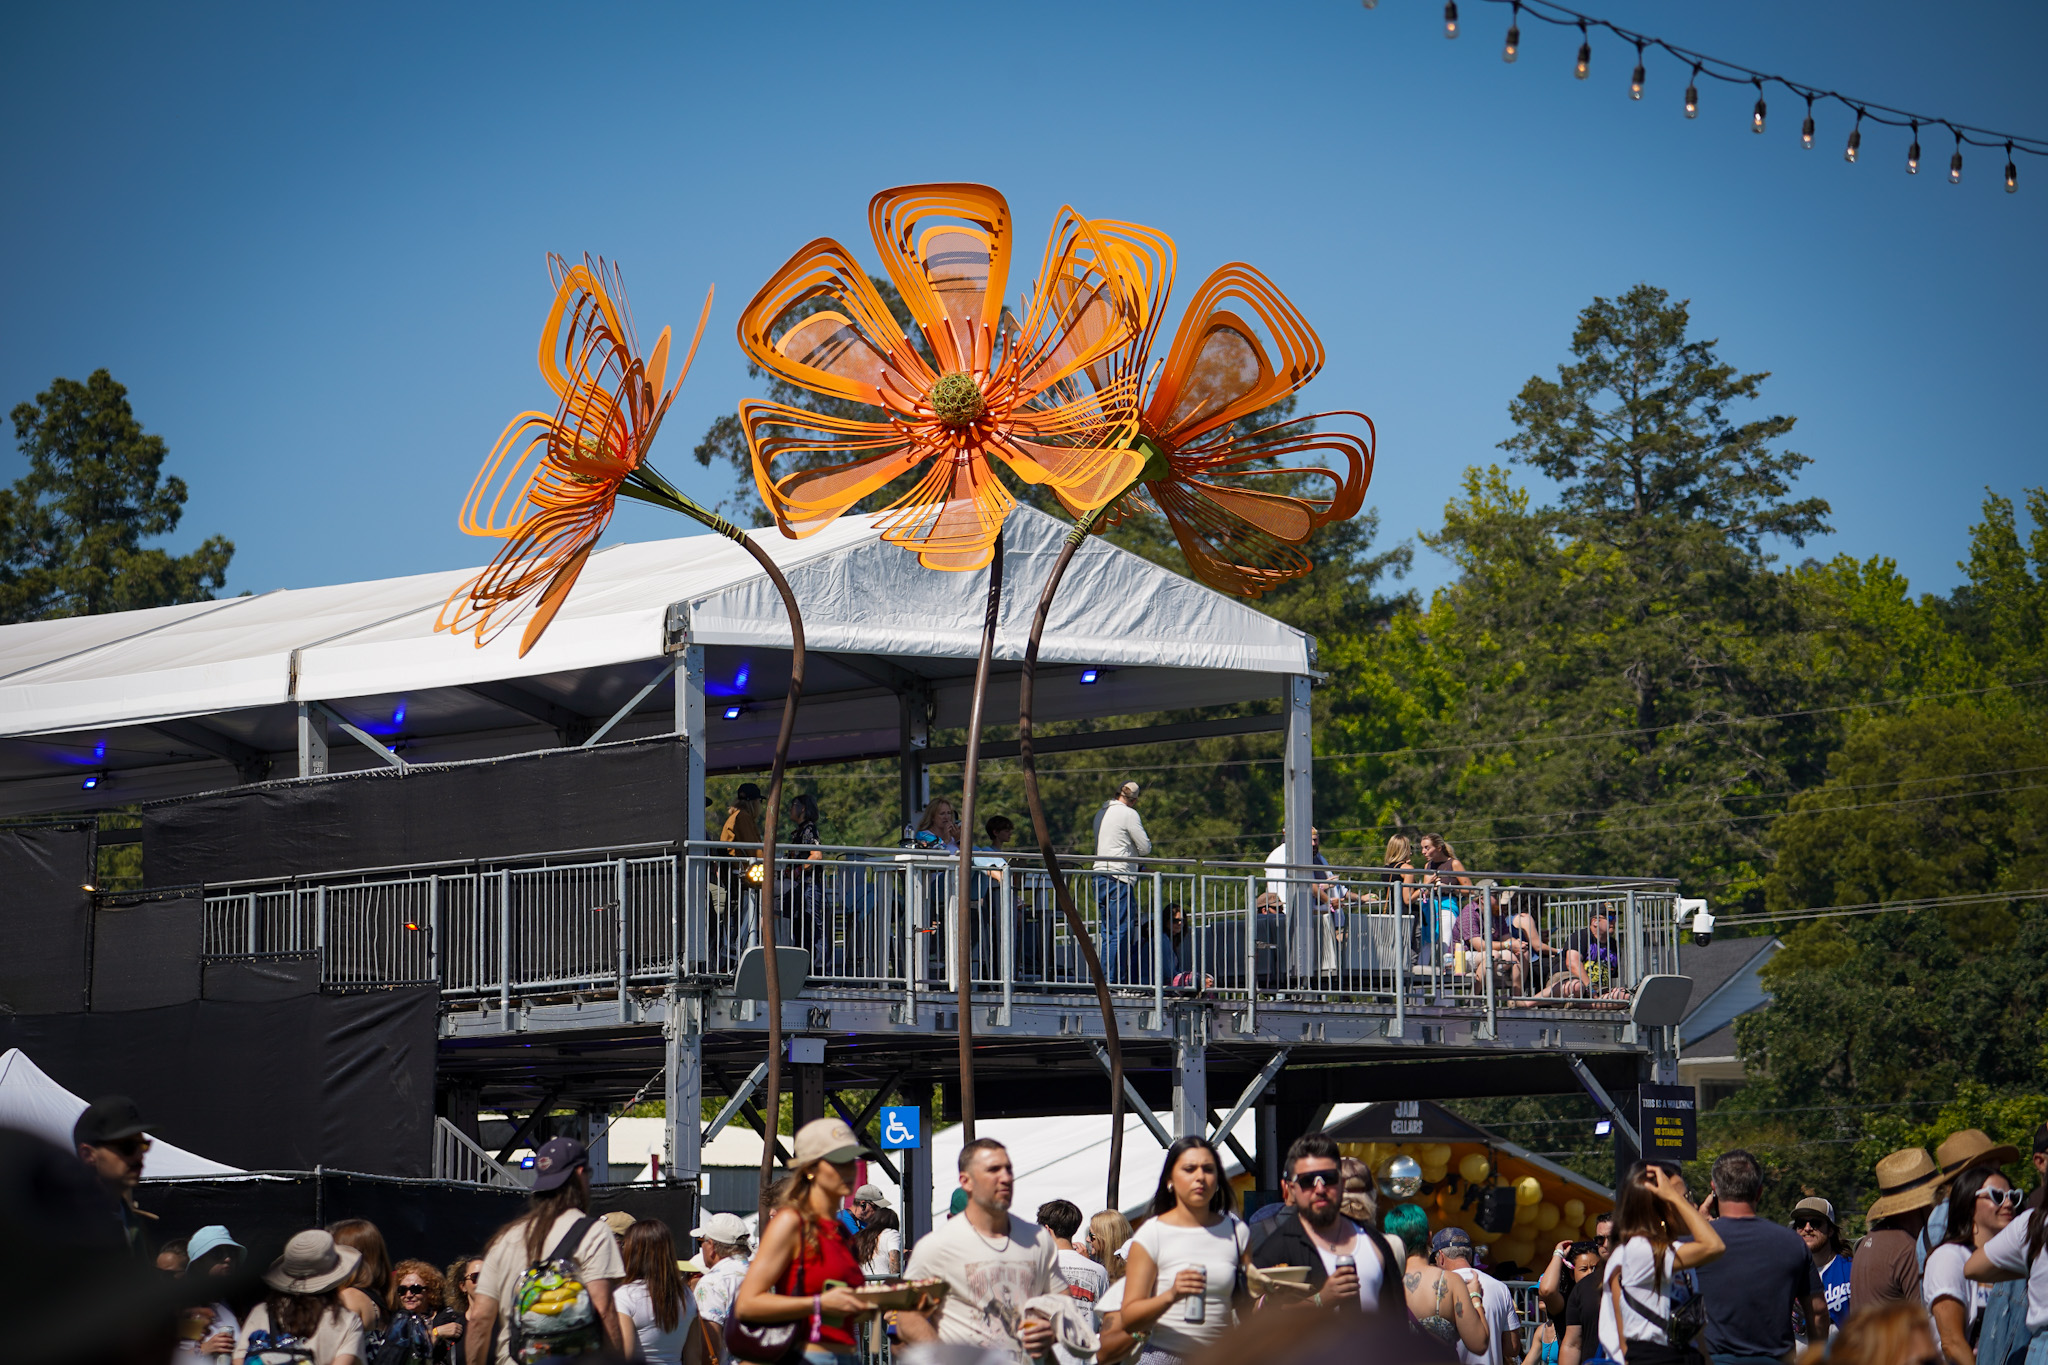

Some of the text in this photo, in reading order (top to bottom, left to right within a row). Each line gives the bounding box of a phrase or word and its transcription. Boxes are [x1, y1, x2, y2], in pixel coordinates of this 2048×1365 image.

[1642, 1098, 1655, 1108] THIS
[1656, 1099, 1662, 1108] IS
[1663, 1100, 1667, 1108] A
[1395, 1101, 1419, 1118] JAM
[1656, 1117, 1662, 1125] NO
[1391, 1120, 1423, 1134] CELLARS
[1654, 1128, 1684, 1136] NO STANDING
[1656, 1138, 1663, 1146] NO
[1824, 1282, 1851, 1312] dger
